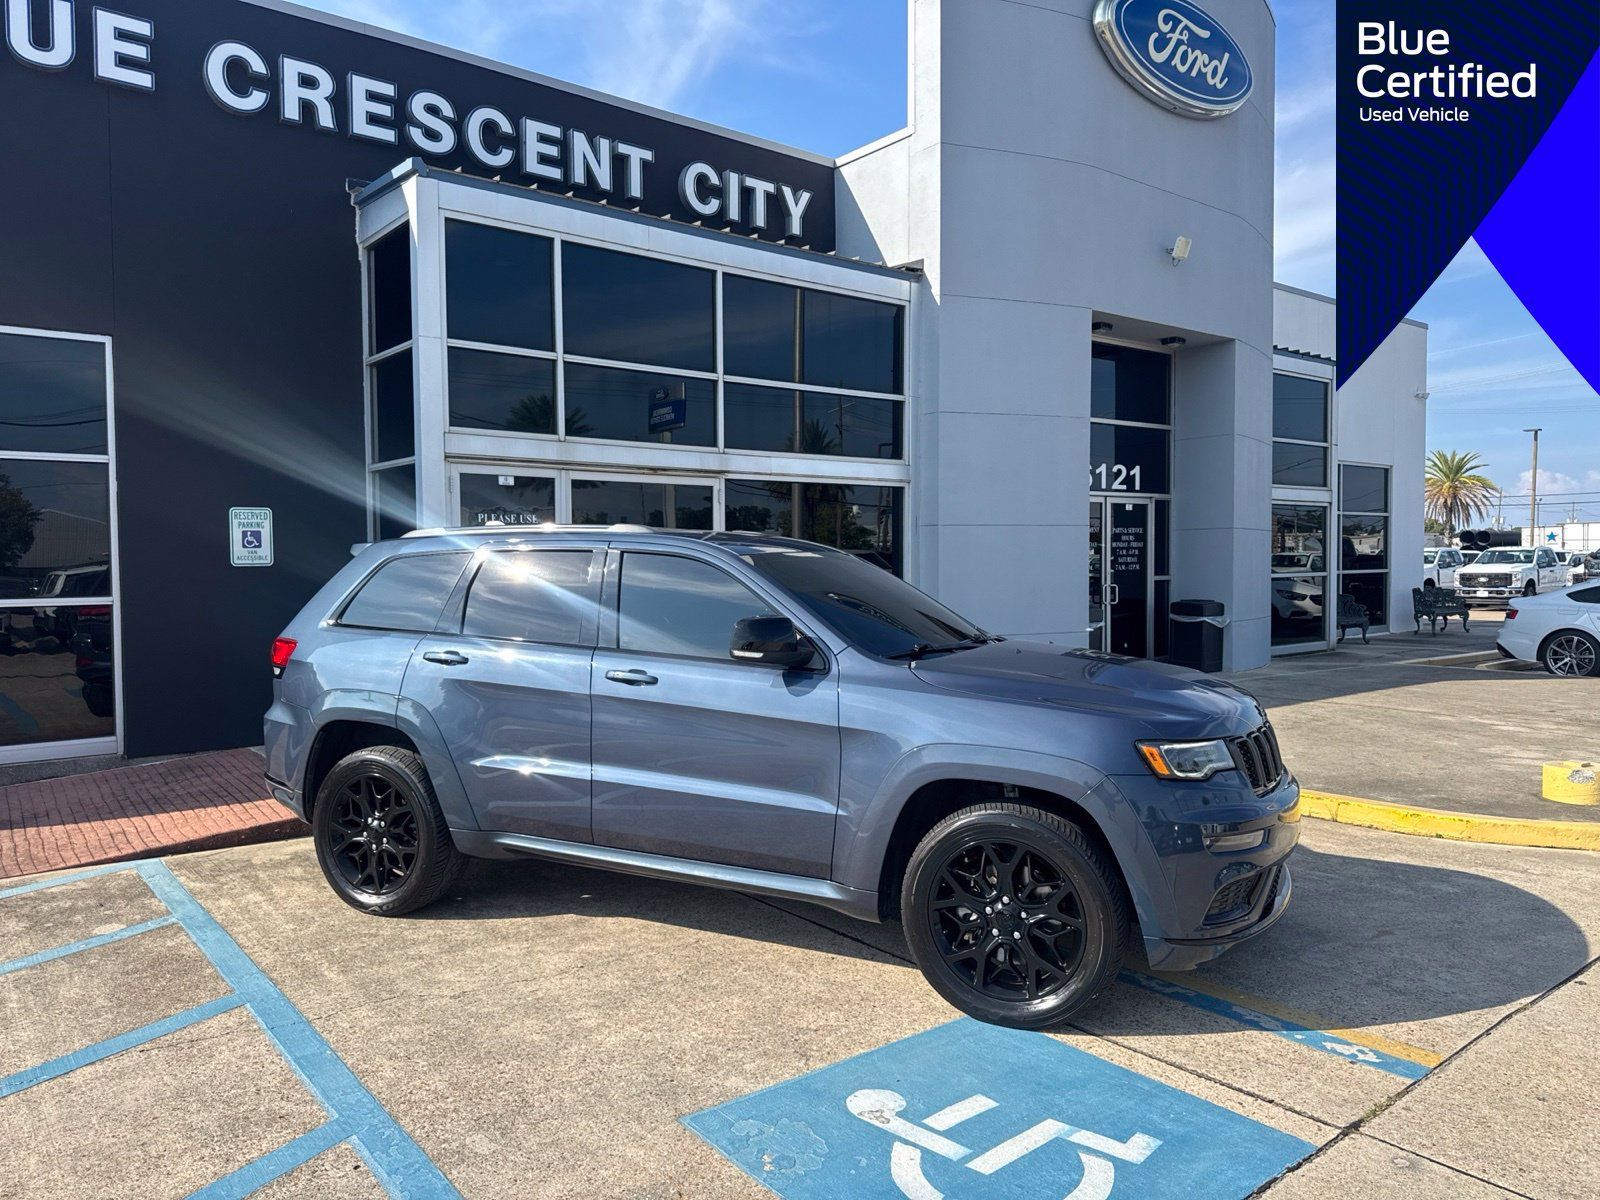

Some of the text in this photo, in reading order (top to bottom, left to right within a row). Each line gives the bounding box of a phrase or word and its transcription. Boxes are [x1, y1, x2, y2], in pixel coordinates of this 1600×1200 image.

[1148, 8, 1228, 90] Ford
[4, 0, 814, 238] UE CRESCENT CITY
[234, 511, 268, 520] RESERVED
[520, 514, 538, 523] USE
[238, 521, 264, 529] PARKING
